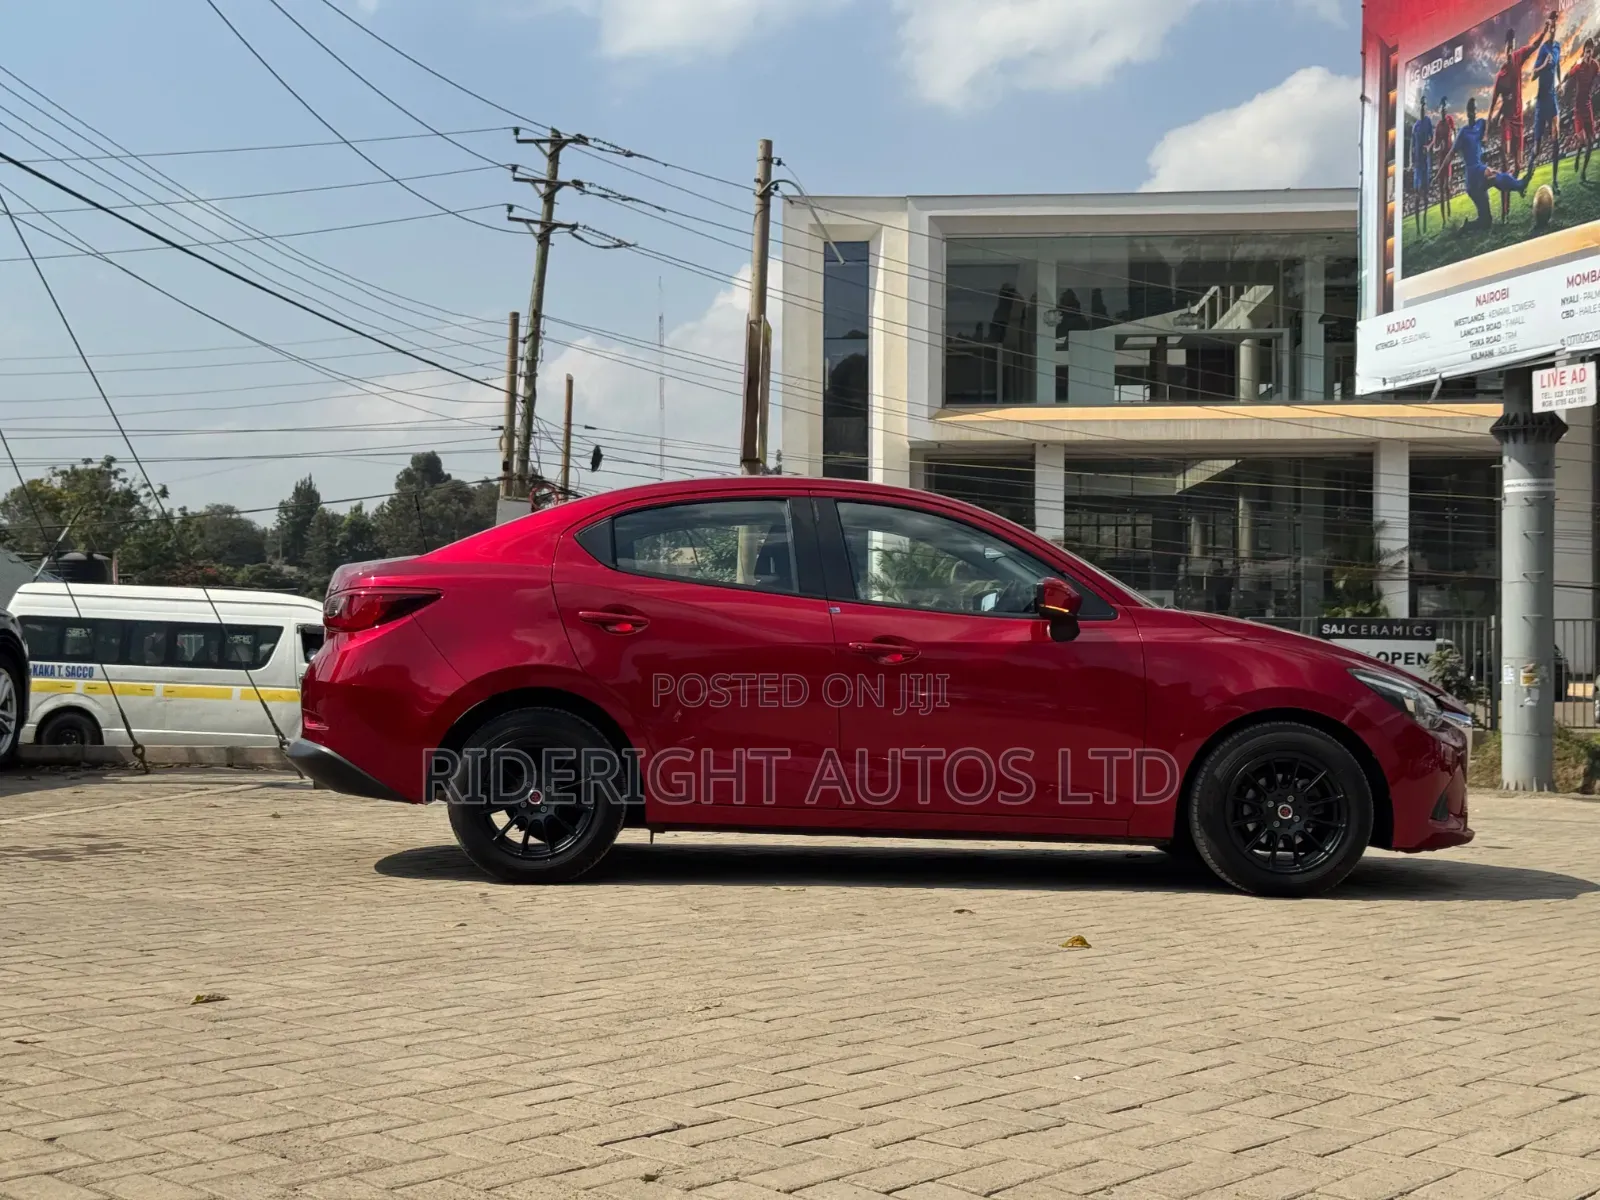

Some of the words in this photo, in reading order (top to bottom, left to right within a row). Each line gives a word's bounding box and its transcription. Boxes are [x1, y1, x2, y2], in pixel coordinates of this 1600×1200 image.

[1475, 287, 1509, 307] NAIROBI
[1561, 309, 1575, 320] CBD
[1486, 321, 1502, 333] ROAD
[1485, 334, 1501, 344] ROAD
[1540, 370, 1567, 388] LIVE
[1571, 367, 1586, 384] AD
[1321, 623, 1346, 635] SAJ
[1347, 624, 1433, 637] CERAMICS
[1376, 651, 1430, 666] OPEN
[33, 664, 55, 677] KAKA
[65, 665, 94, 678] SACCO
